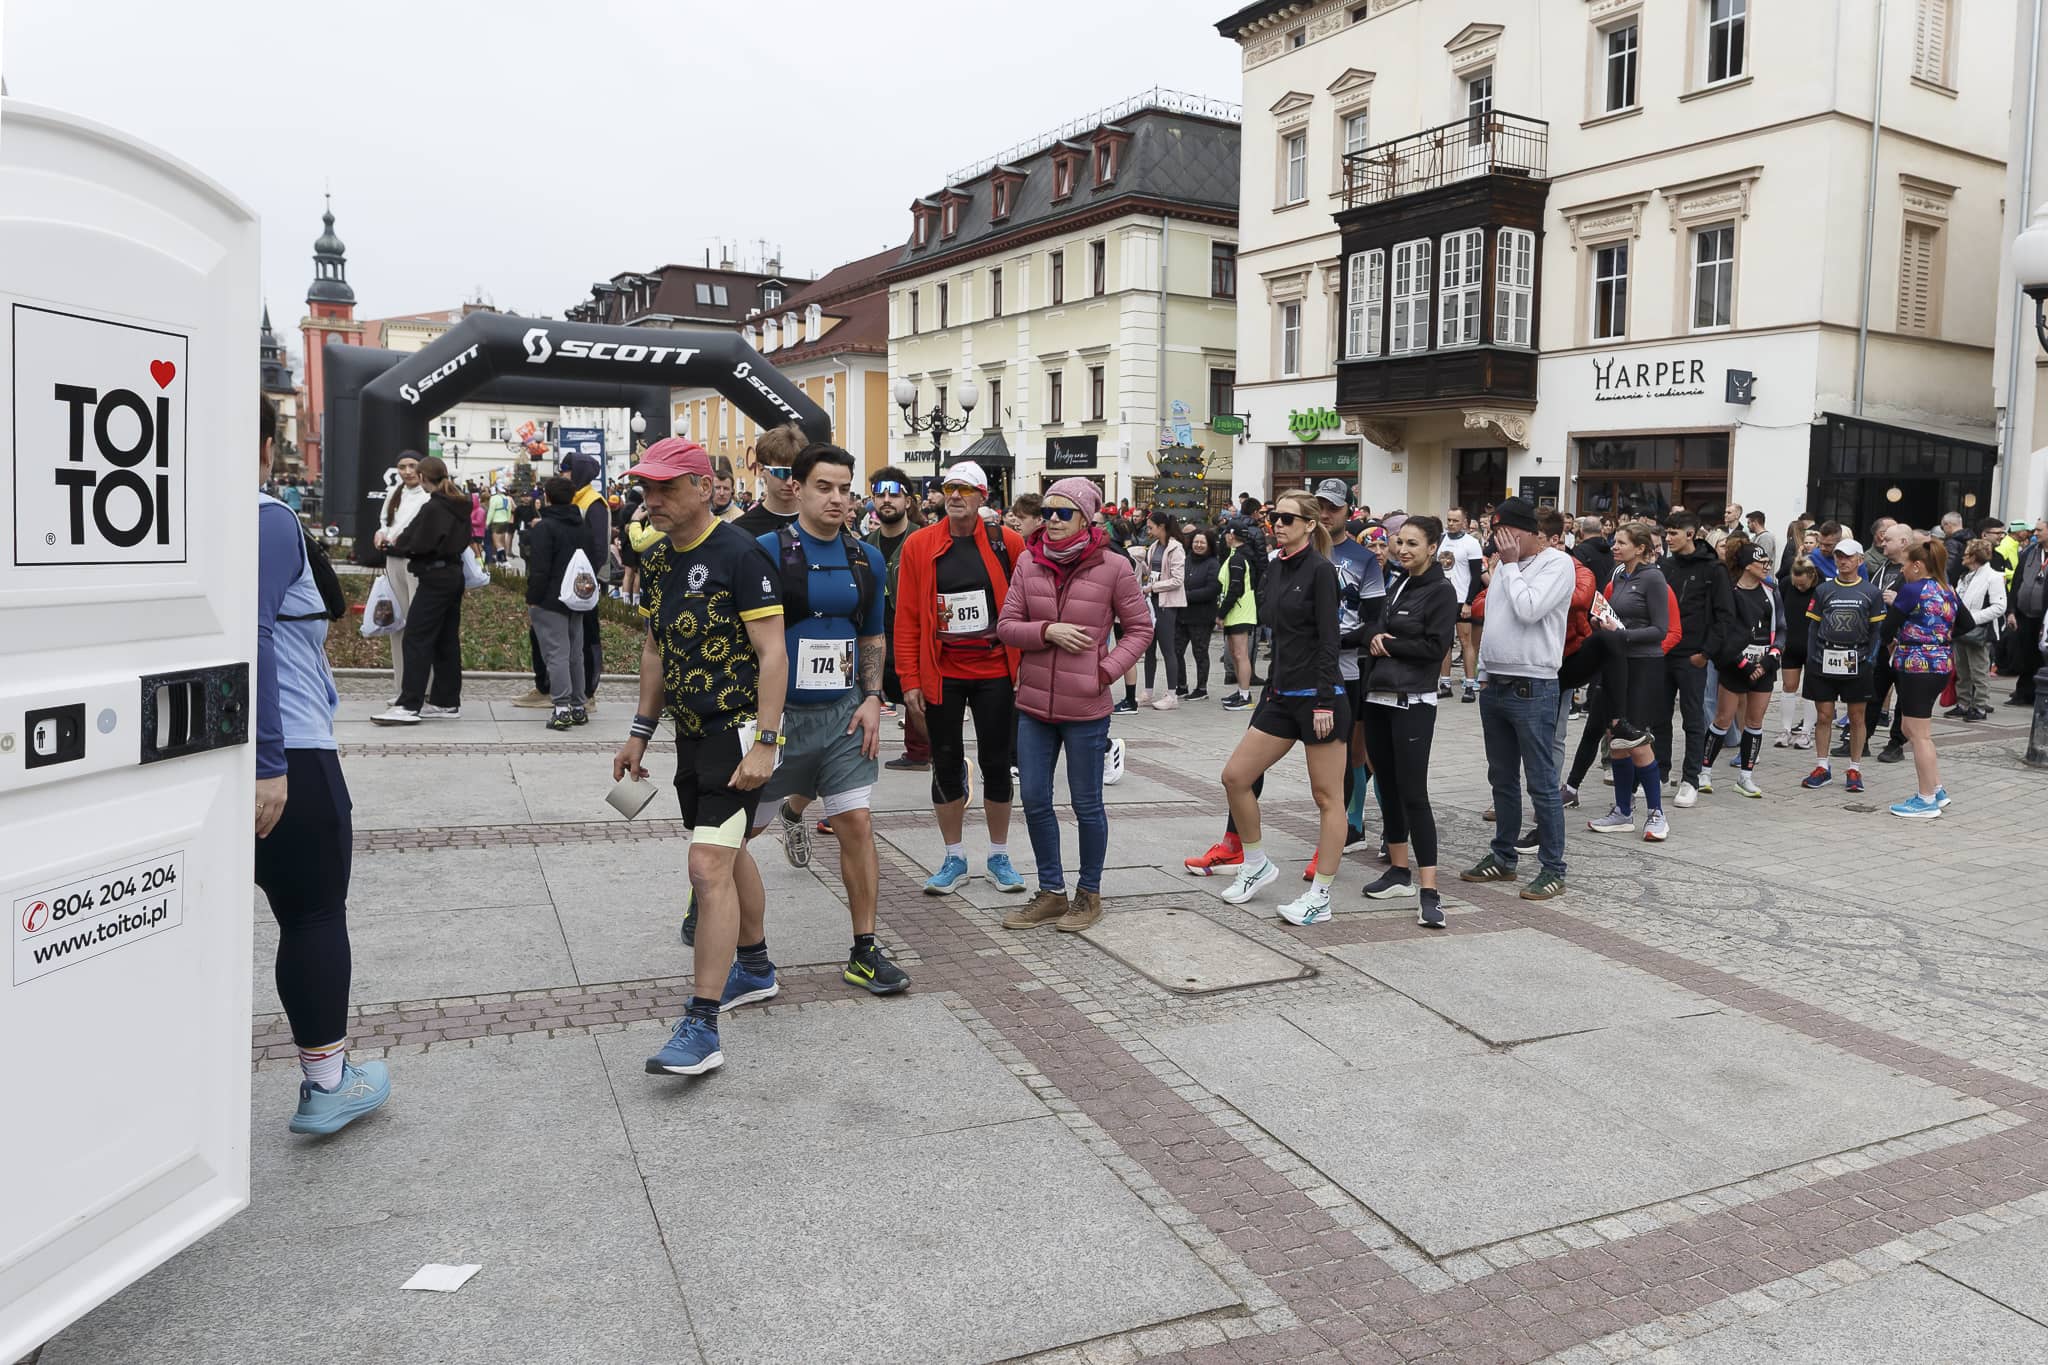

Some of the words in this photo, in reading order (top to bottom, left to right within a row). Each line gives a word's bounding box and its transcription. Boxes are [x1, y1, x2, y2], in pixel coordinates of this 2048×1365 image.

[417, 343, 479, 393] SCOTT
[555, 340, 701, 365] SCOTT
[1593, 357, 1706, 390] HARPER
[745, 374, 803, 421] SCOTT
[1654, 387, 1705, 398] cukiernia
[54, 382, 170, 468] TOI
[1288, 407, 1341, 431] żabka
[54, 468, 170, 548] TOI
[958, 605, 979, 621] 875
[810, 656, 835, 674] 174
[1828, 658, 1842, 667] 441
[52, 889, 95, 921] 804
[99, 876, 137, 907] 204
[141, 863, 177, 892] 204
[33, 899, 168, 965] www.toitoi.pl
